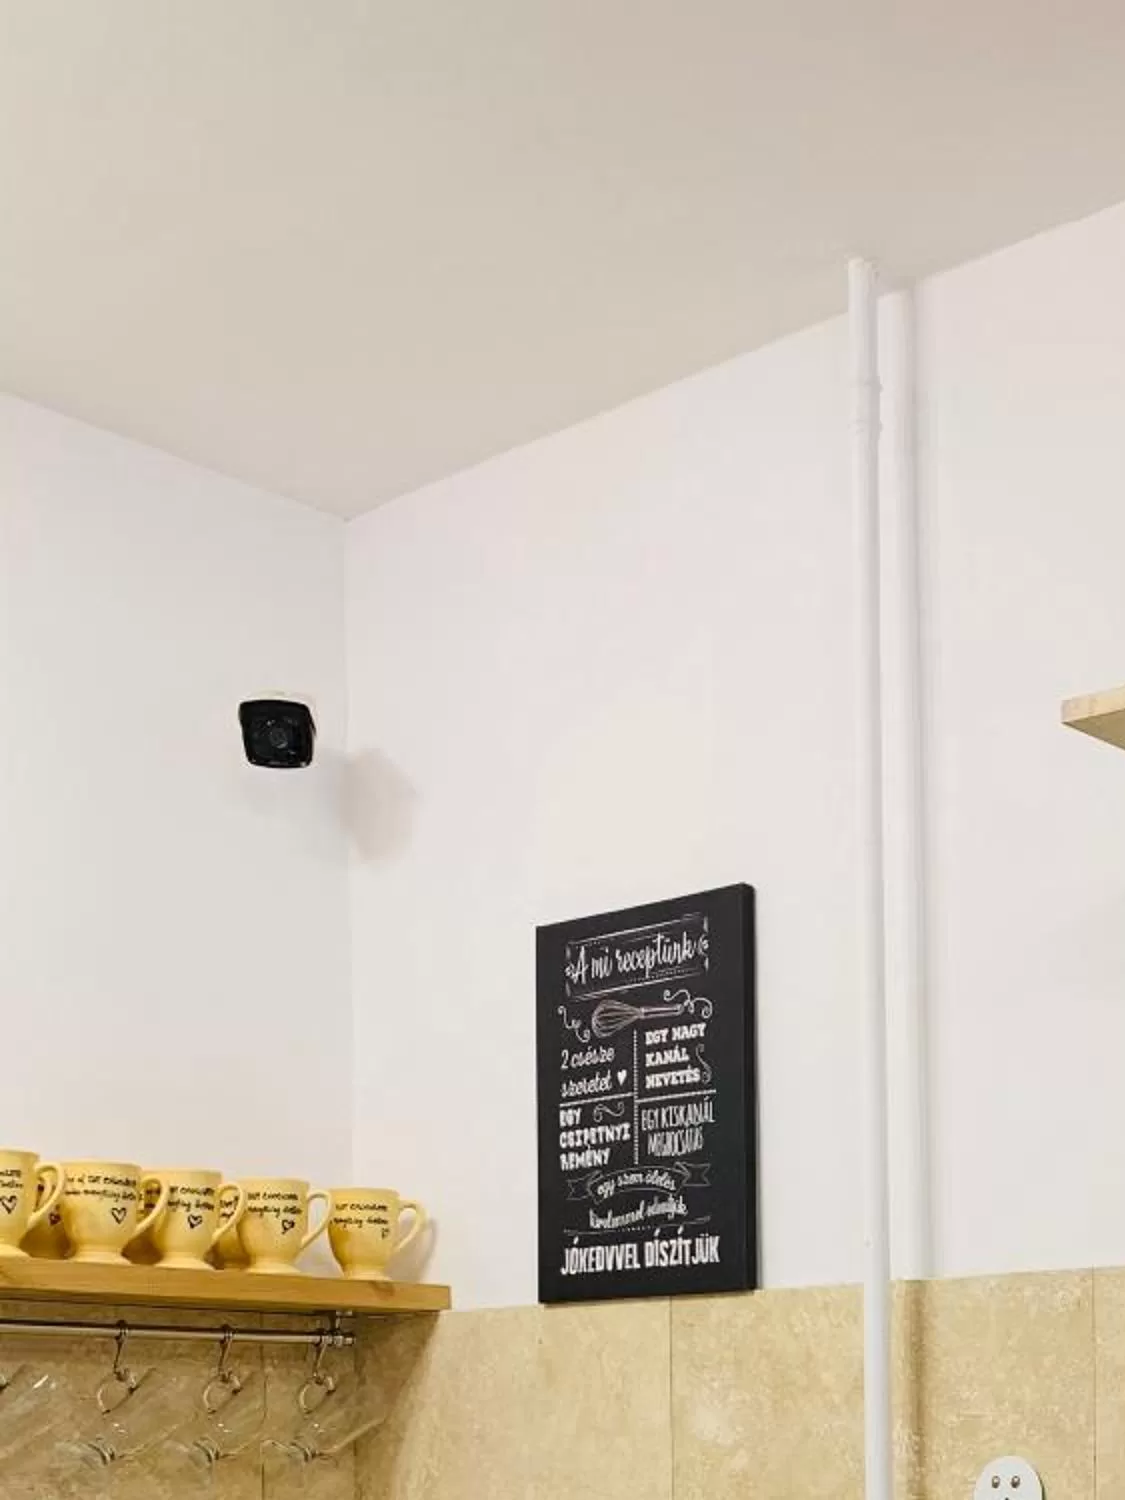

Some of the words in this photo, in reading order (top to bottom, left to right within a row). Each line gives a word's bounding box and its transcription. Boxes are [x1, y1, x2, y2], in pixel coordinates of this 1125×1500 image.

[571, 945, 588, 985] A
[591, 946, 613, 979] mi
[672, 1022, 707, 1041] NAGY
[560, 1048, 569, 1069] 2
[645, 1043, 690, 1067] KANÁL
[645, 1063, 701, 1089] NEVETÉS
[560, 1235, 641, 1275] JÓKEDVVEL
